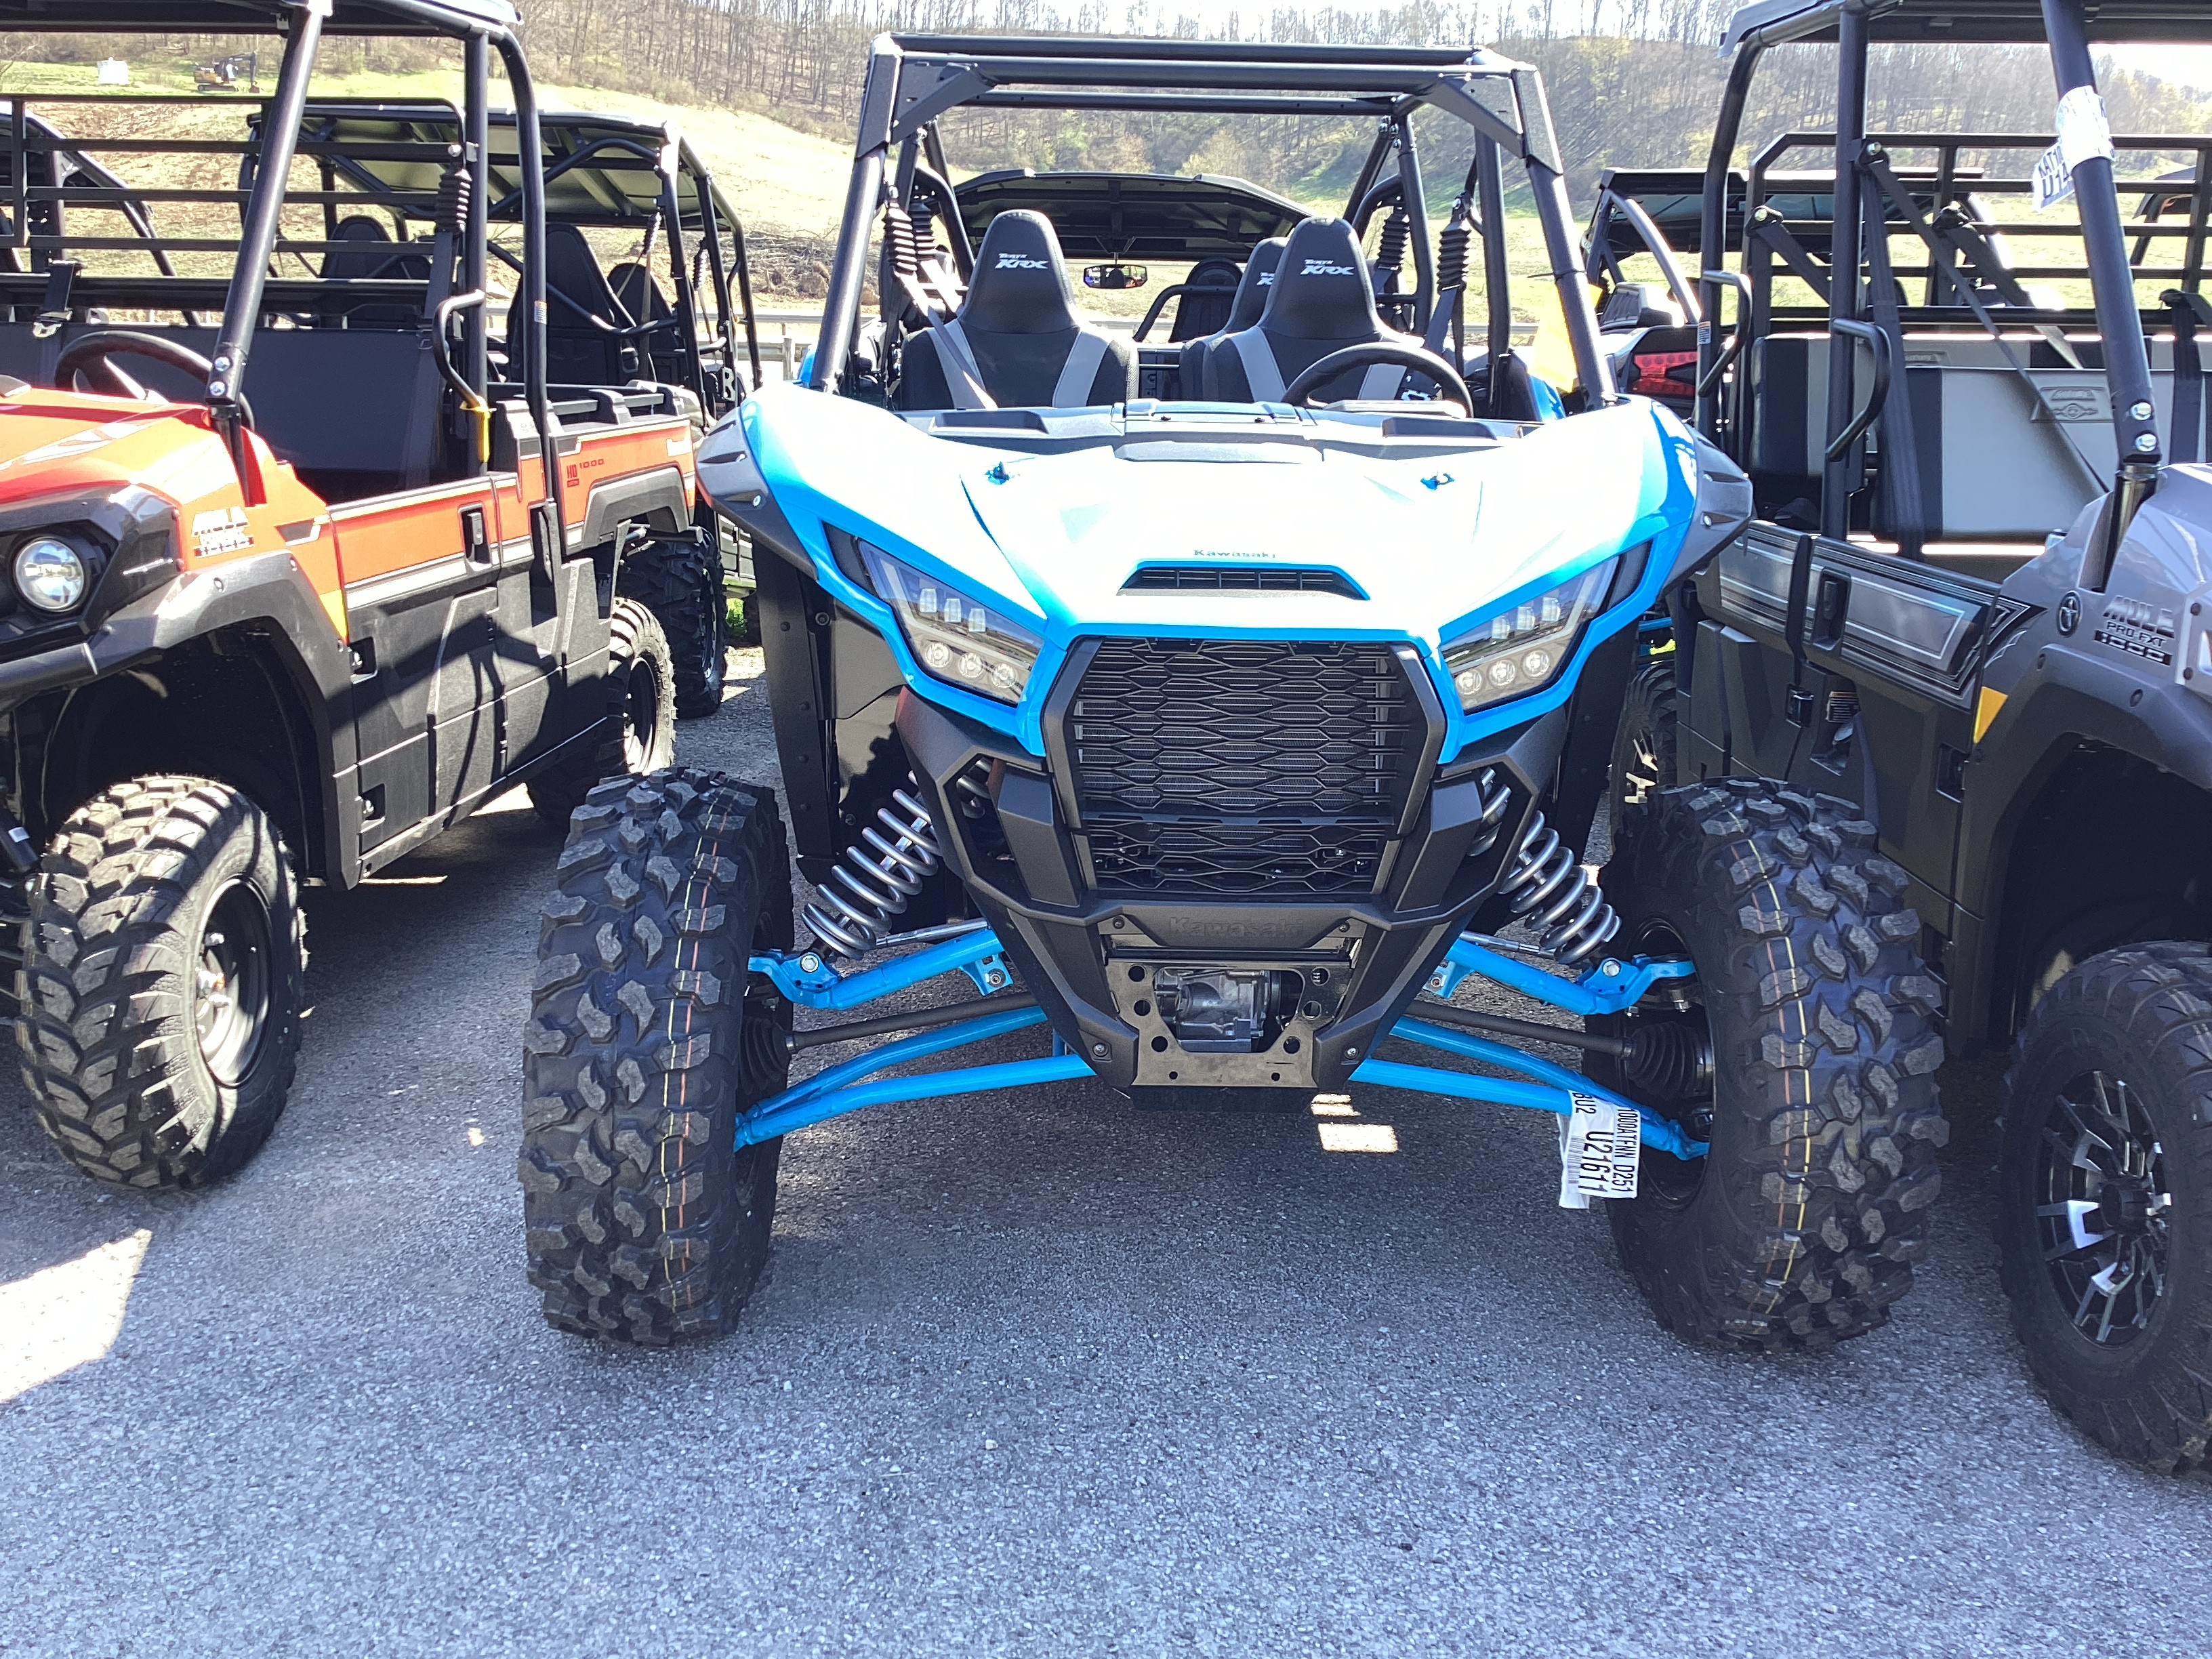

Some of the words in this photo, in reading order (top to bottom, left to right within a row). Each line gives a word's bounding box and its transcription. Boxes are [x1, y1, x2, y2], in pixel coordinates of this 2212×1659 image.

[995, 259, 1049, 269] KRX
[1300, 265, 1355, 275] KRX
[579, 459, 605, 469] 1000
[1194, 550, 1275, 558] Kawasaki
[1170, 916, 1305, 937] Kawasaki
[1578, 1130, 1615, 1193] U21611
[1611, 1164, 1635, 1193] D251
